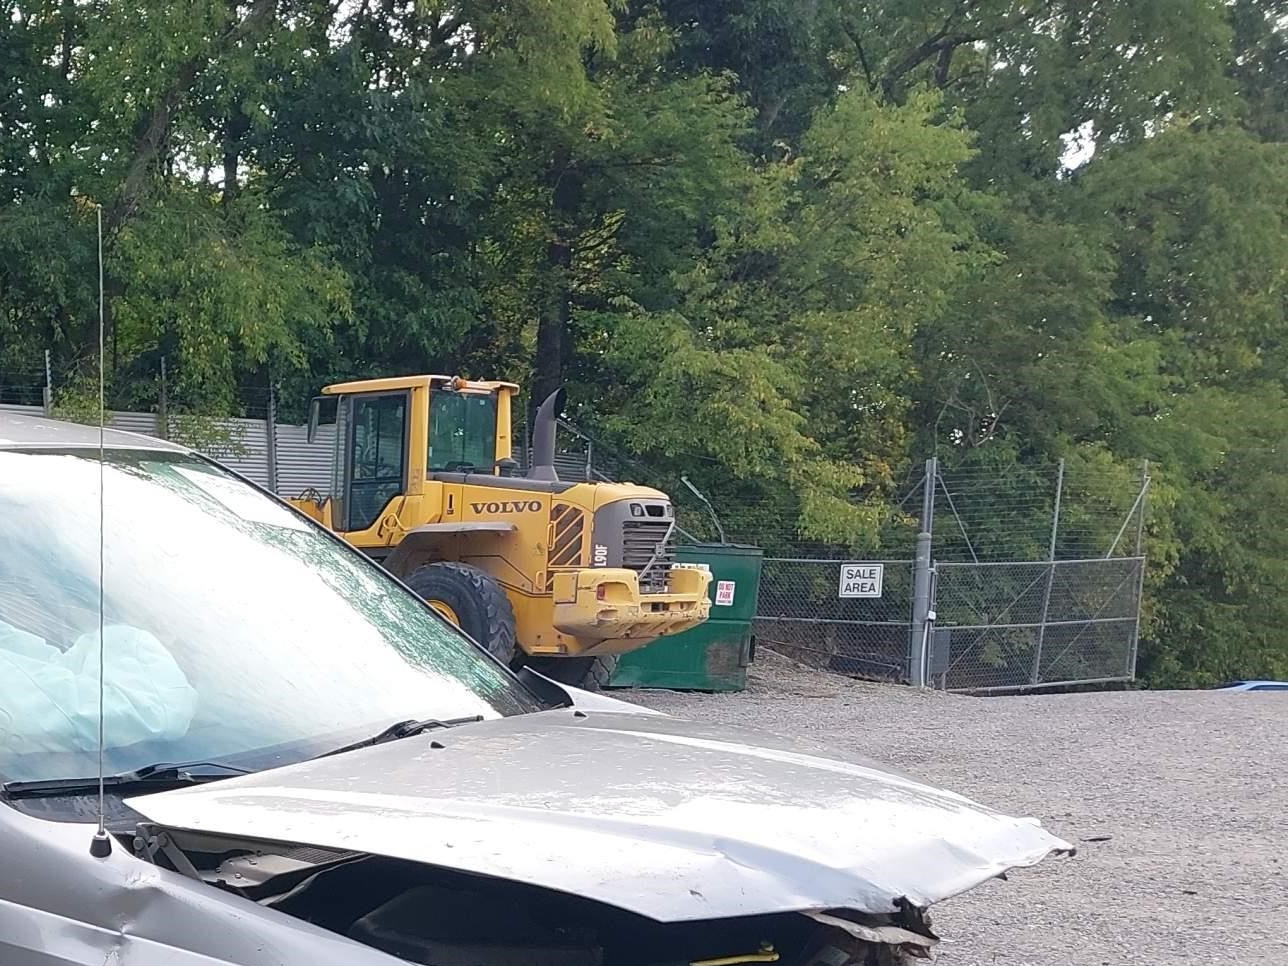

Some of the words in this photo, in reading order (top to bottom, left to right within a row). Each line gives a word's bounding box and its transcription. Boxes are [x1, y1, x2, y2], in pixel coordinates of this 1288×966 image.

[470, 501, 542, 514] VOLVO
[594, 544, 608, 566] L90F
[846, 569, 877, 580] SALE
[844, 582, 876, 593] AREA
